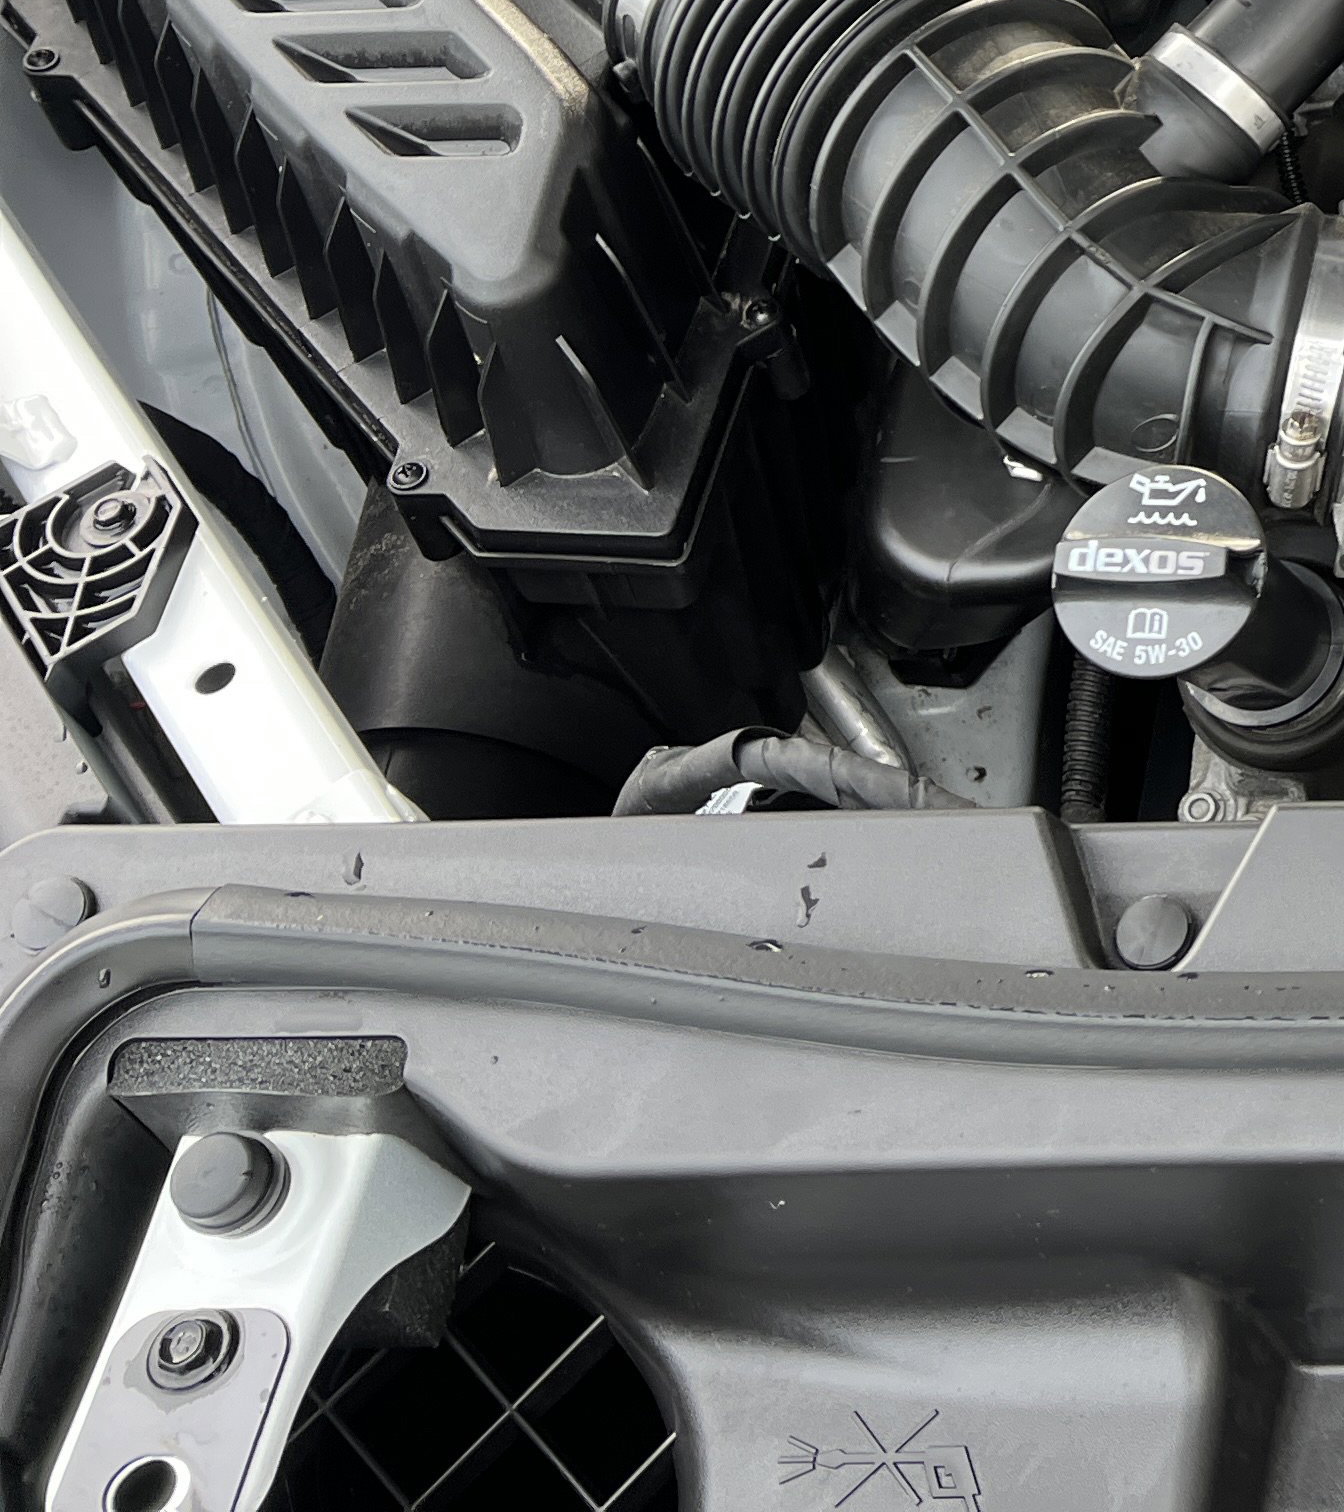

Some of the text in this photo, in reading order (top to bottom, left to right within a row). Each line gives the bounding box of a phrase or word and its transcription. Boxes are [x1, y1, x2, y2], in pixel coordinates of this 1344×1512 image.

[1067, 540, 1209, 576] dexos
[1089, 629, 1203, 665] SAE 5W-30
